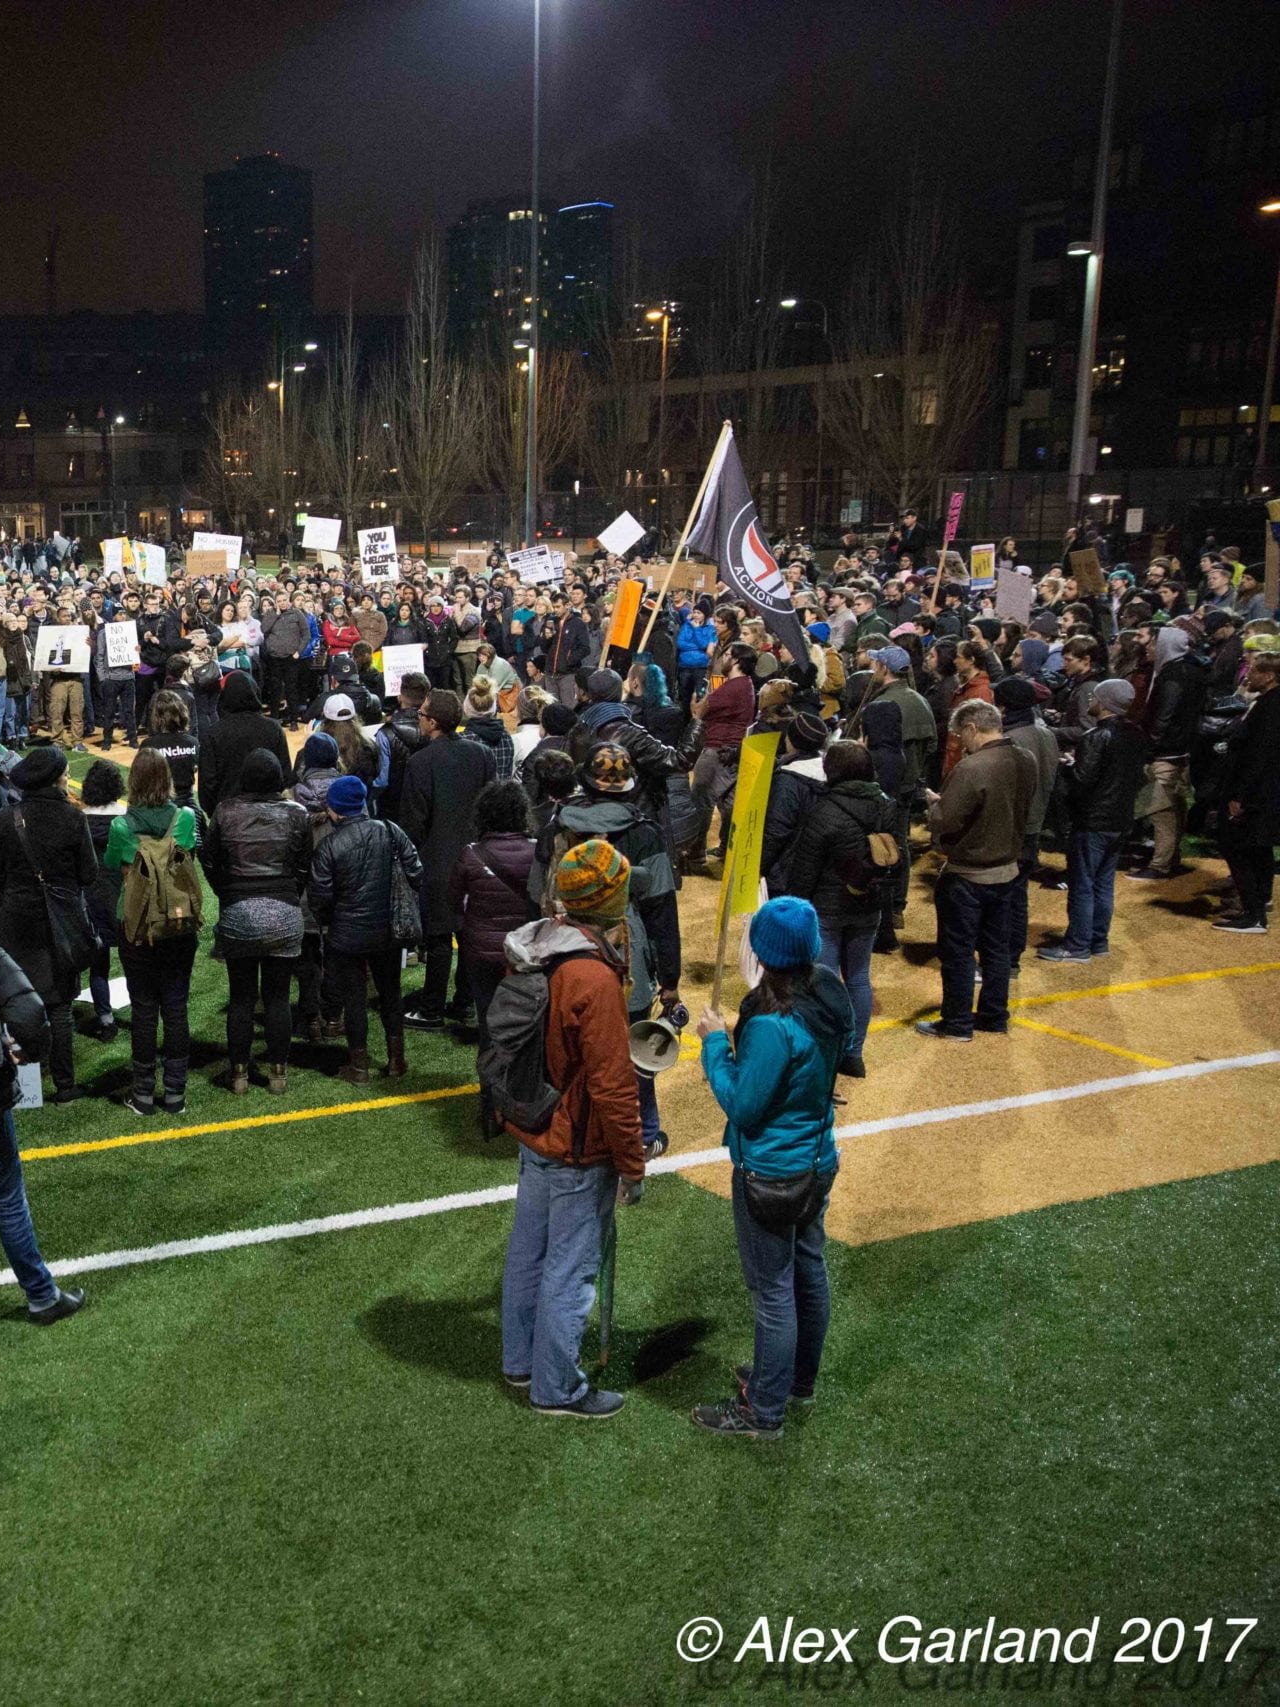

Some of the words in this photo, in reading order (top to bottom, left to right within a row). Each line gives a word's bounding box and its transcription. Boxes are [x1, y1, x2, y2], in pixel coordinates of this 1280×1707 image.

[367, 531, 387, 543] YOU
[364, 544, 379, 555] ARE
[362, 553, 396, 565] WELCOME
[370, 564, 389, 576] HERE
[734, 566, 773, 605] ACTION
[110, 625, 123, 635] NO
[109, 636, 128, 646] BAN
[113, 645, 126, 653] NO
[110, 654, 133, 663] WALL
[739, 808, 758, 895] HATE
